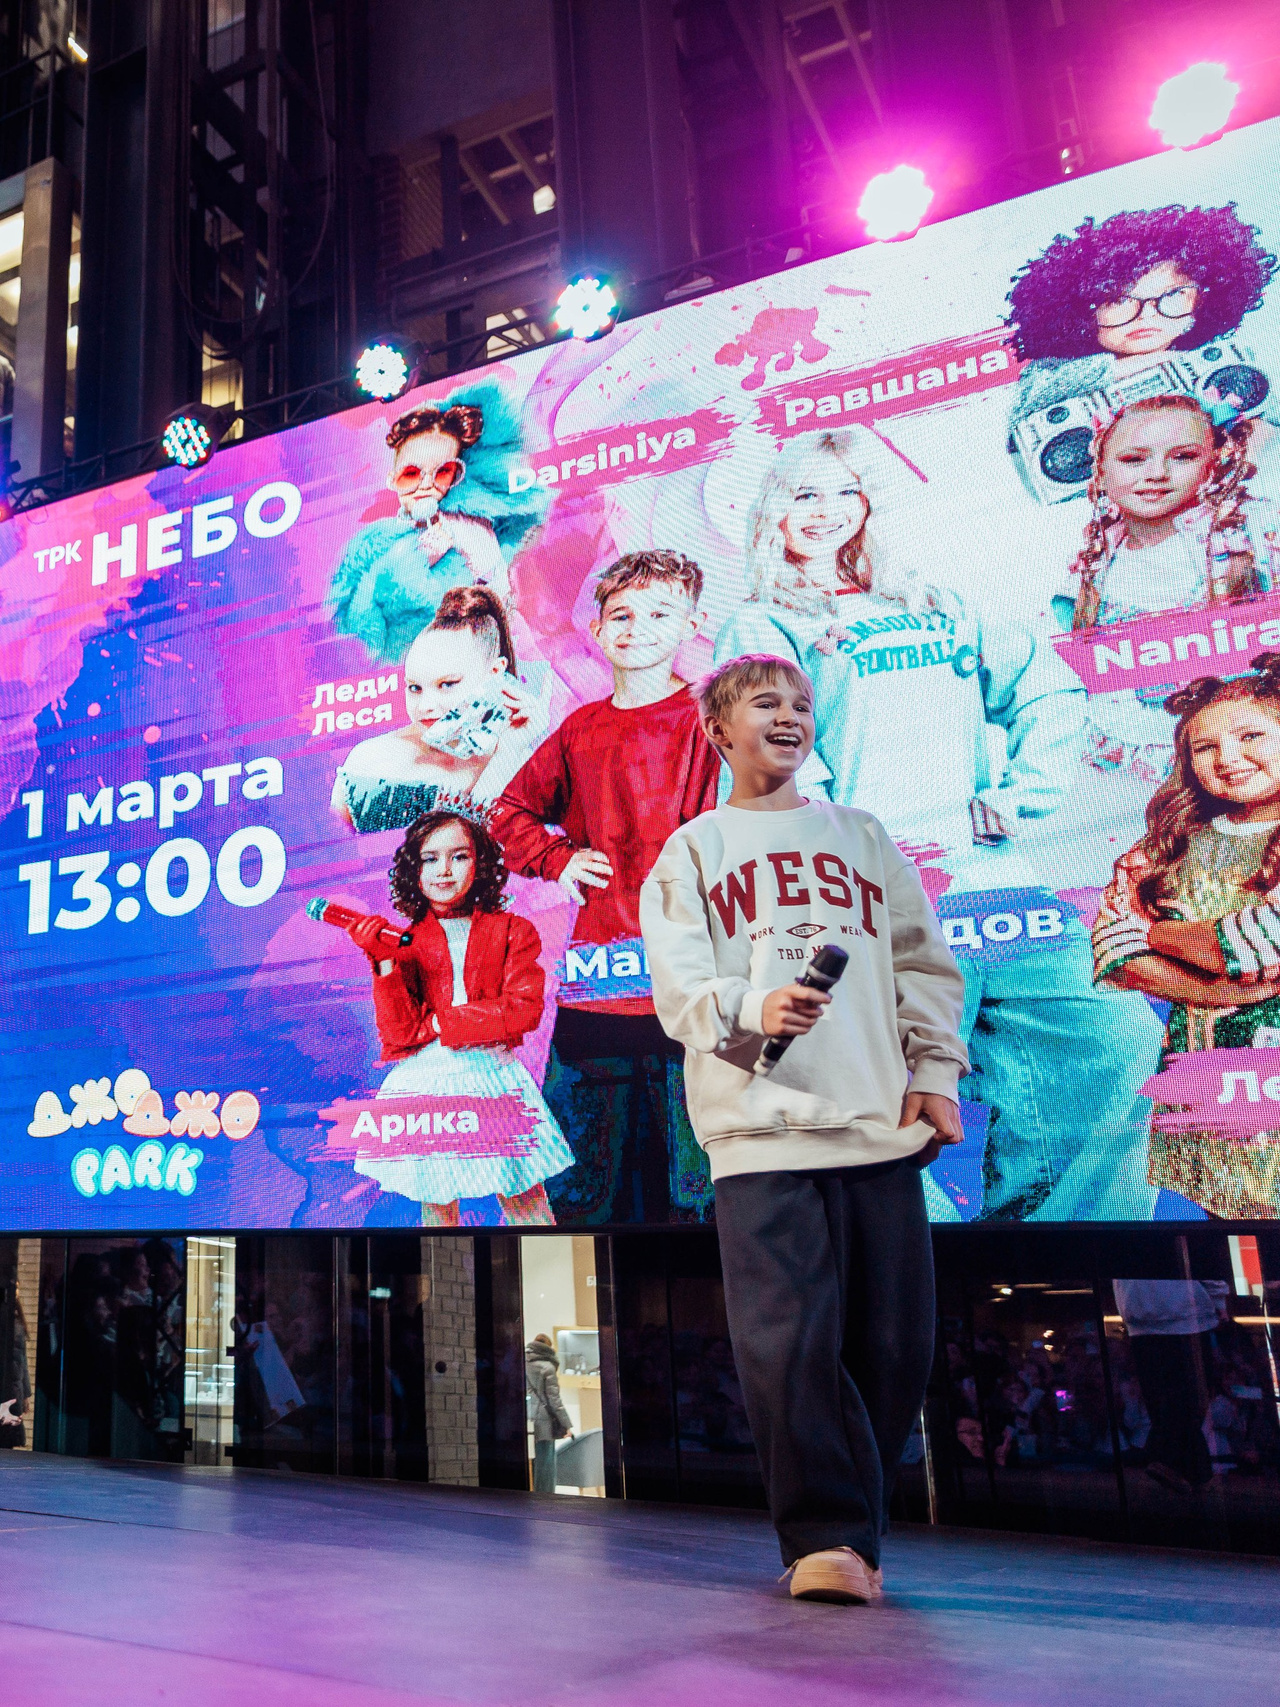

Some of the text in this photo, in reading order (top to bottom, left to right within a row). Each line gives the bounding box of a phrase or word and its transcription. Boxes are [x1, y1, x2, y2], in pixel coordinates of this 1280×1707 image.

[784, 348, 1009, 427] Равшана
[507, 424, 697, 494] Darsiniya
[33, 481, 302, 586] ТРК НЕБО
[312, 673, 398, 708] Леди
[312, 703, 393, 736] Леся
[21, 756, 284, 839] 1 марта
[18, 826, 287, 935] 13:00
[708, 851, 883, 939] WEST
[749, 925, 775, 942] WORK
[778, 948, 809, 960] TRD.
[350, 1109, 480, 1143] Арика
[71, 1139, 204, 1198] PARK
